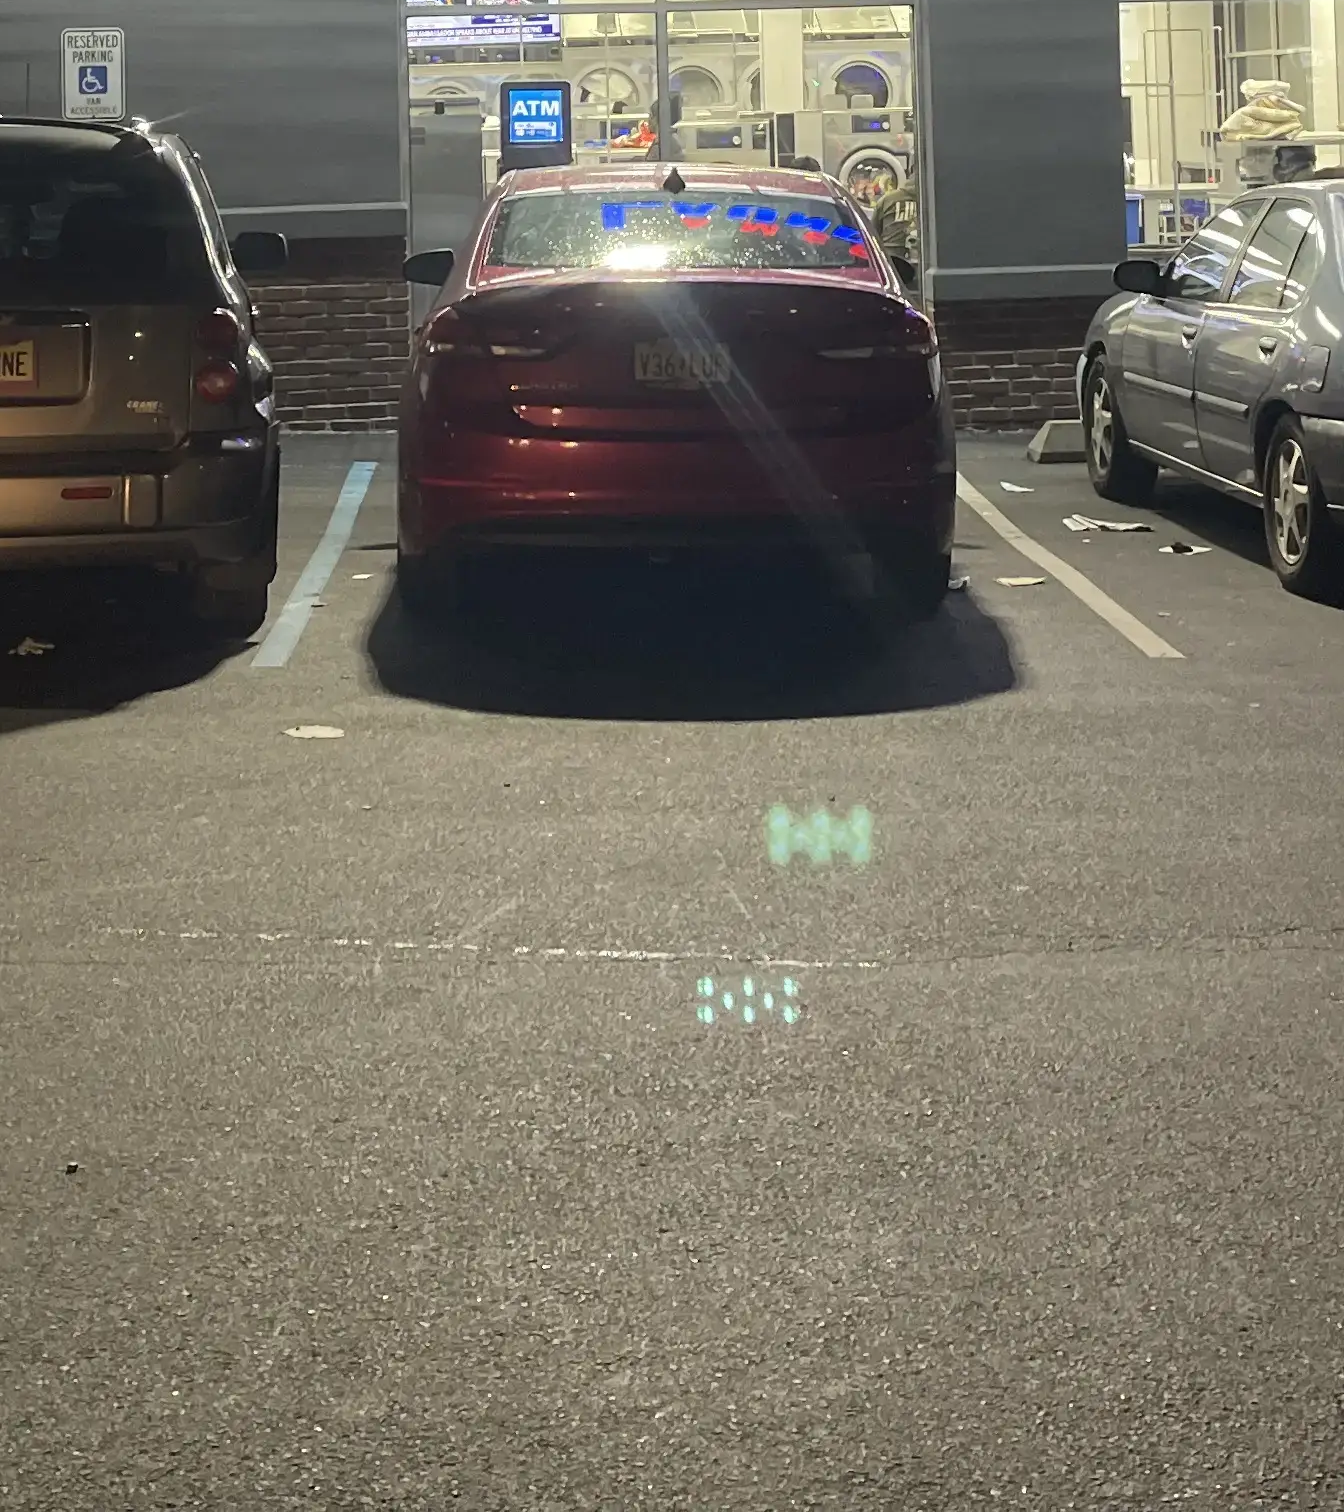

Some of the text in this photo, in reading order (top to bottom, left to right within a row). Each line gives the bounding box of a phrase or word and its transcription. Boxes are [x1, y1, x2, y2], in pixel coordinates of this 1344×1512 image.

[67, 35, 118, 48] RESERVED
[72, 50, 114, 63] PARKING
[512, 100, 560, 116] ATM
